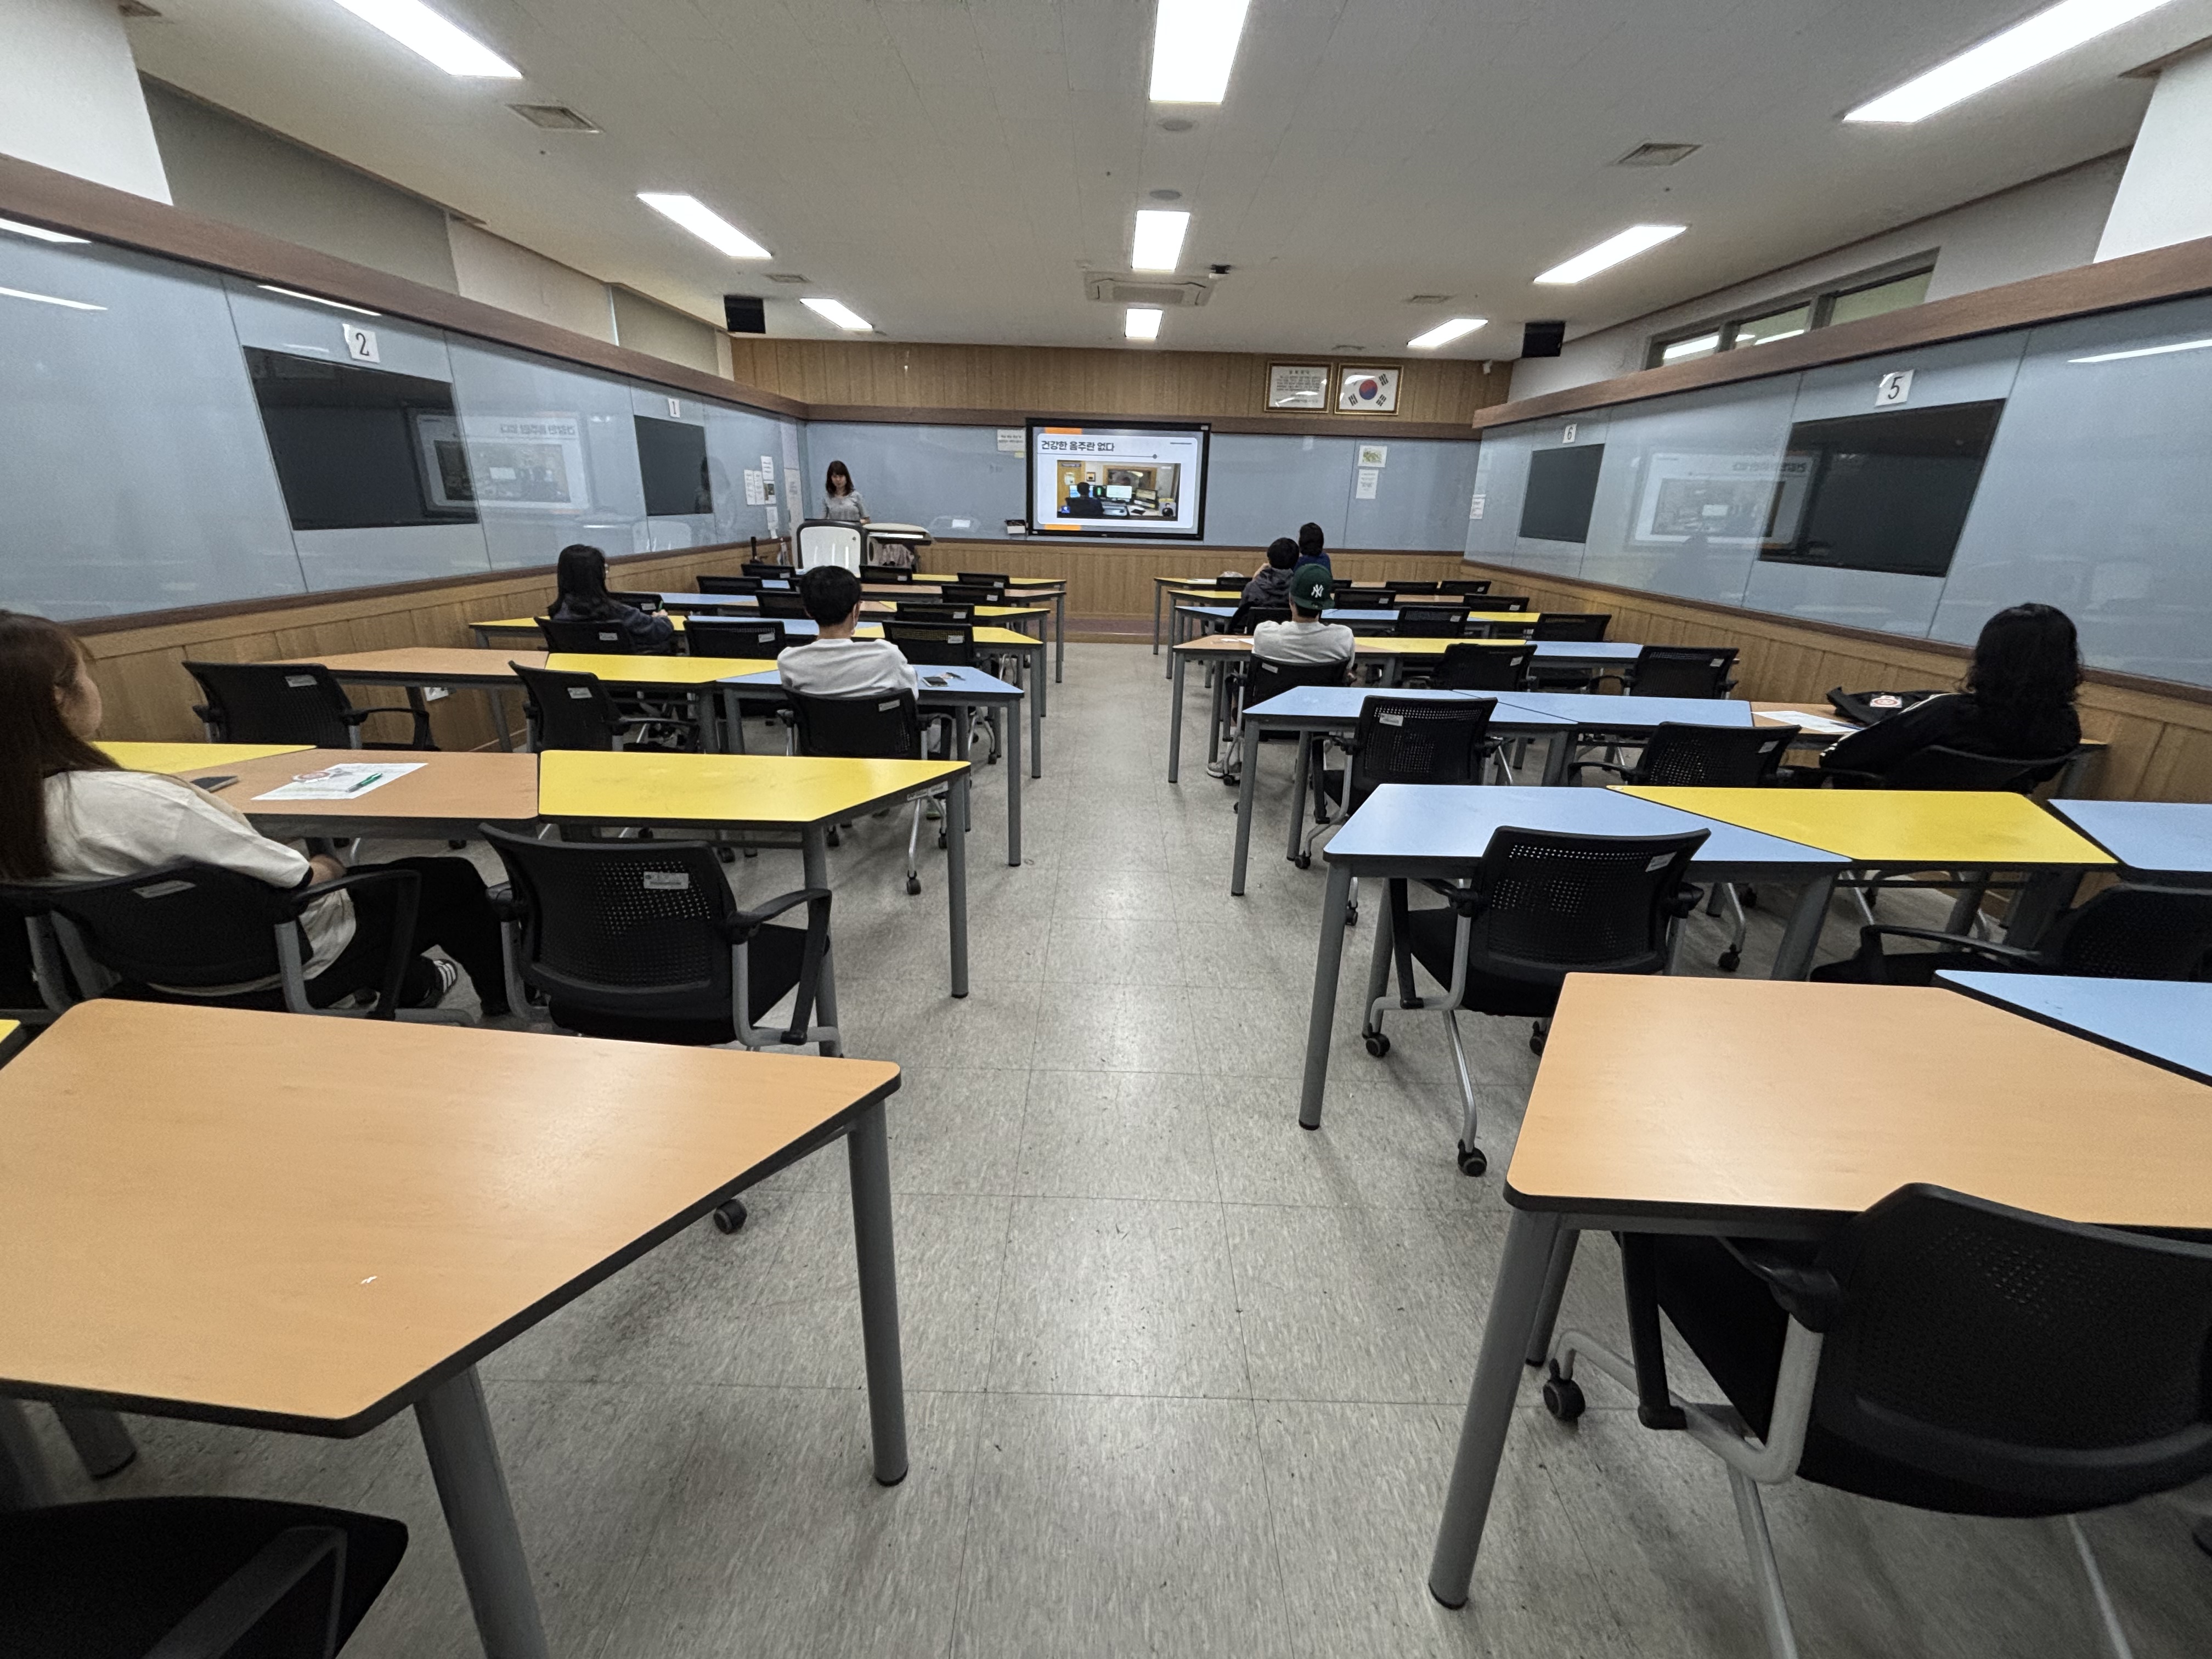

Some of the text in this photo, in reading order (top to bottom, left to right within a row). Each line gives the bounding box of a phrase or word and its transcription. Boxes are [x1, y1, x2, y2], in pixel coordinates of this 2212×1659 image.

[356, 332, 370, 356] 2
[1887, 376, 1905, 399] 5
[672, 400, 677, 415] 1
[1567, 426, 1573, 440] 6
[1041, 441, 1068, 450] 건강한
[1097, 442, 1115, 452] 없다
[1311, 584, 1324, 598] NY
